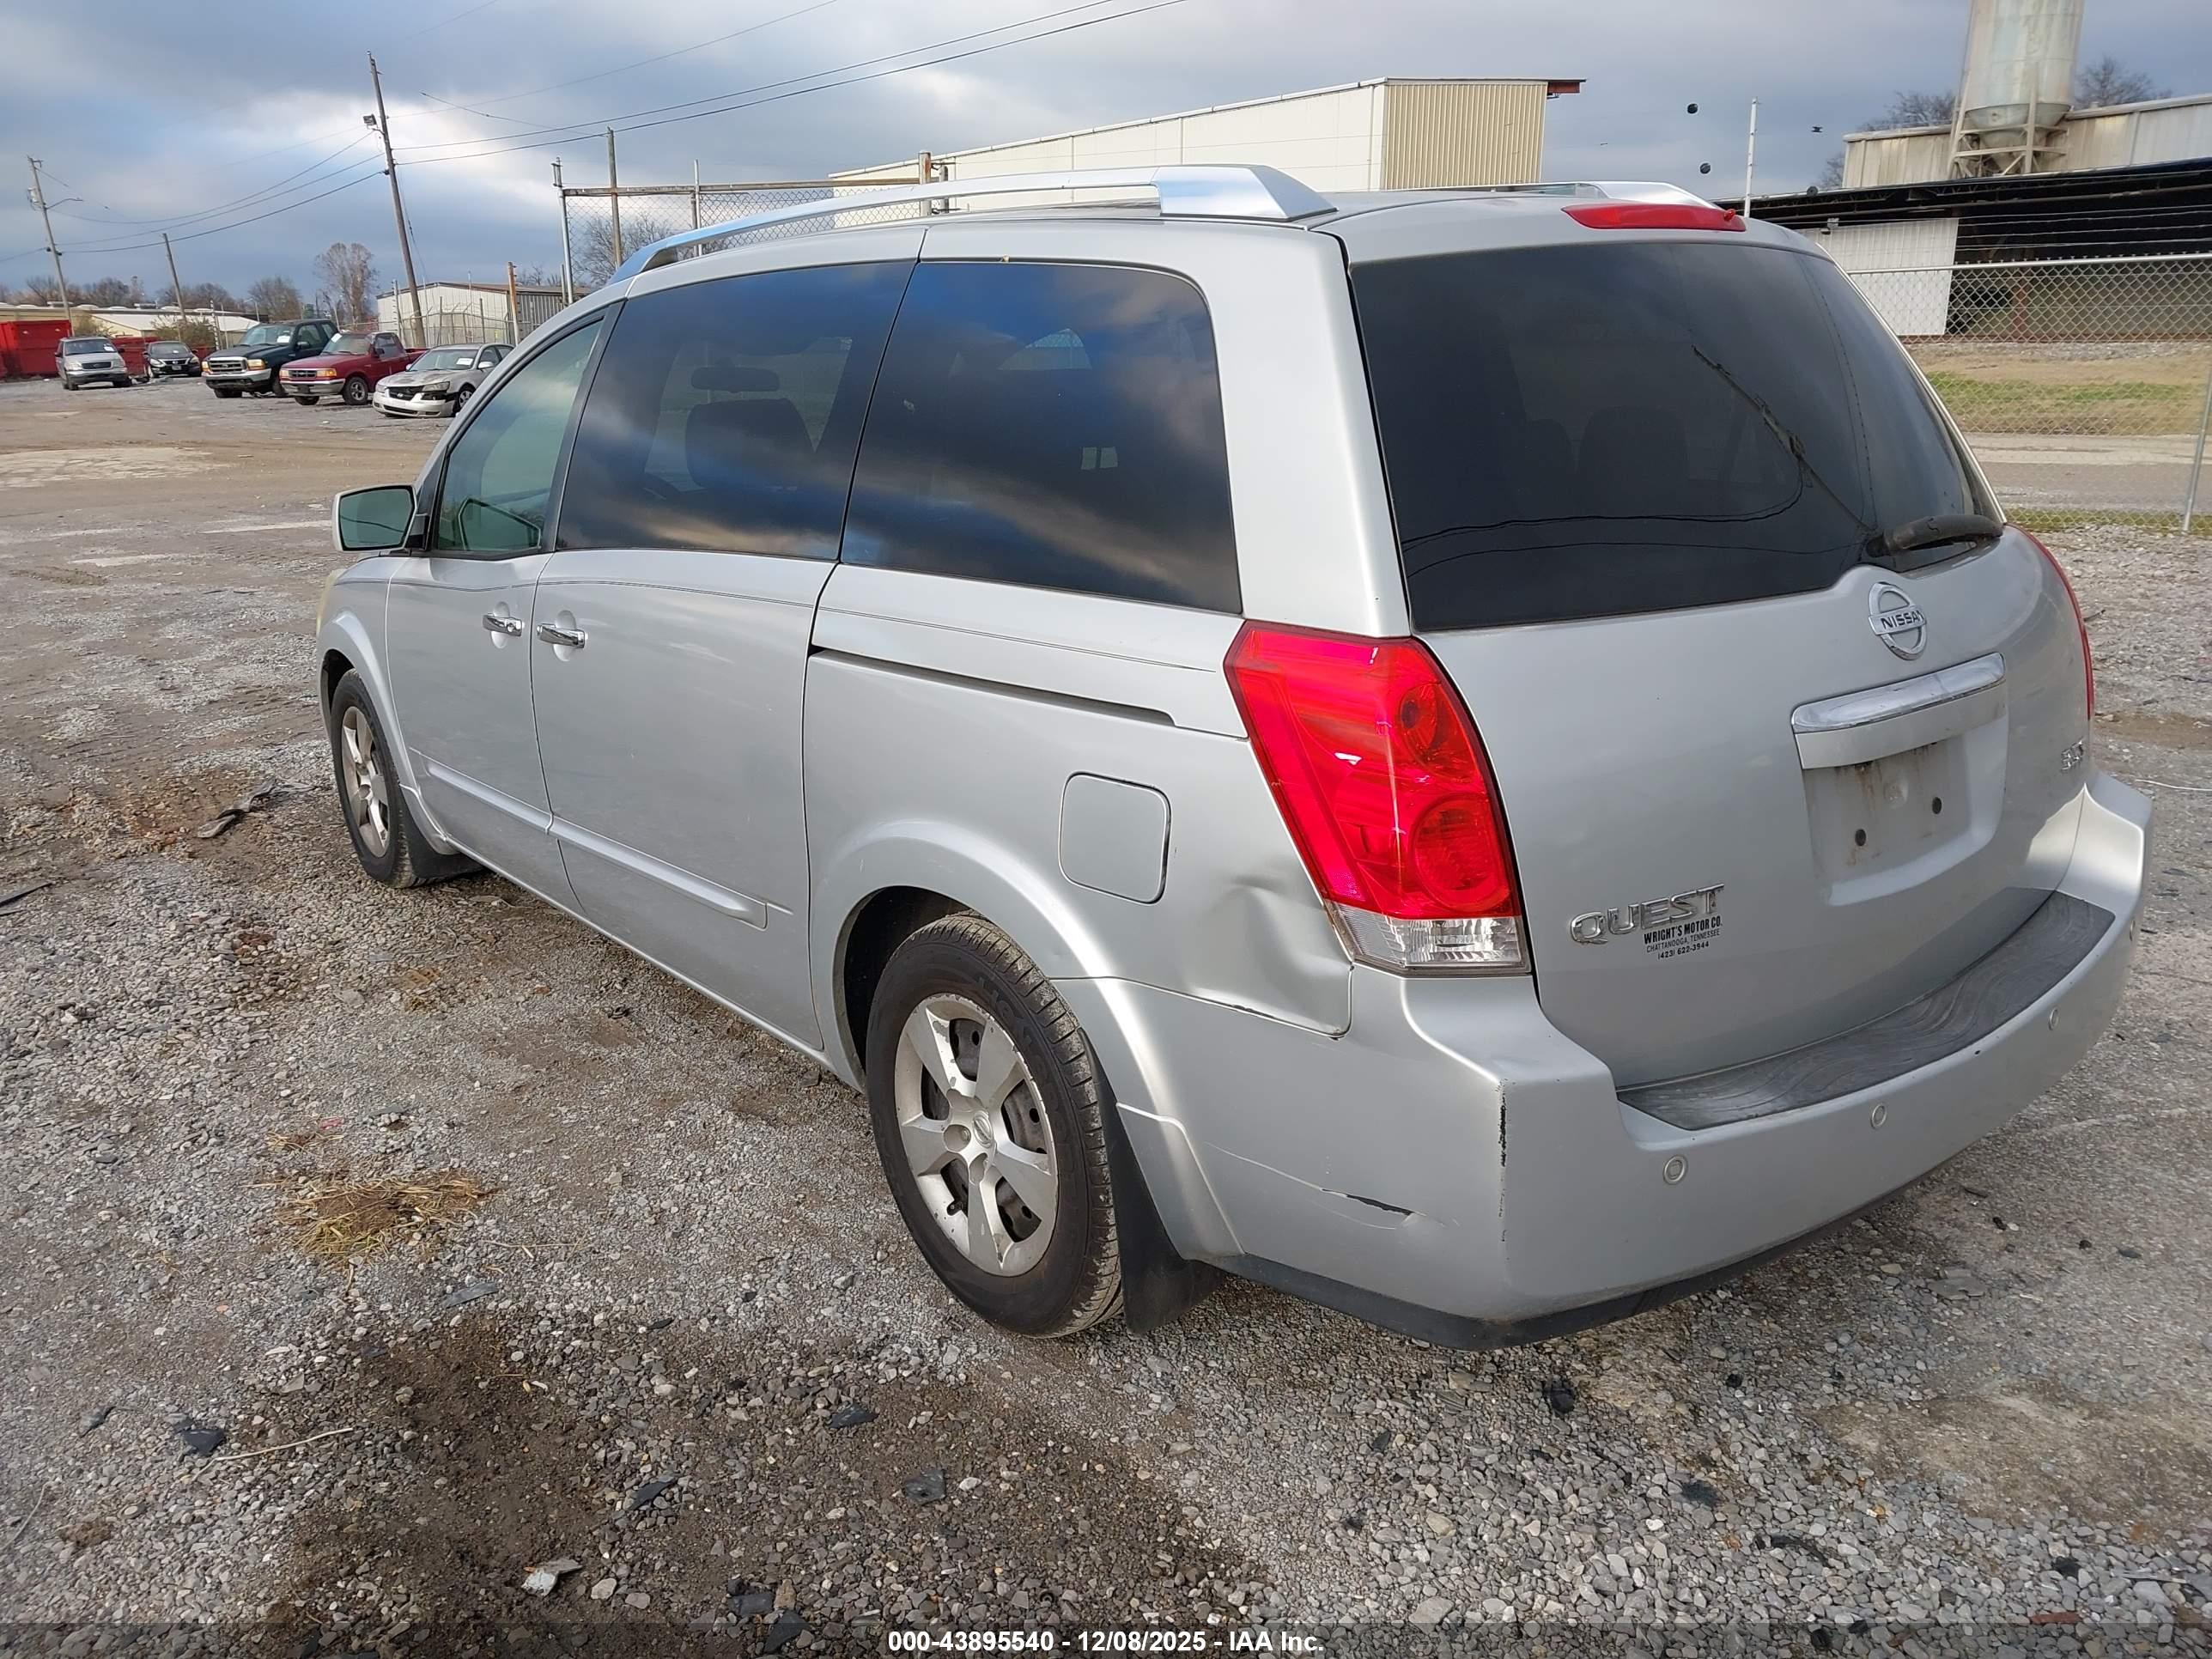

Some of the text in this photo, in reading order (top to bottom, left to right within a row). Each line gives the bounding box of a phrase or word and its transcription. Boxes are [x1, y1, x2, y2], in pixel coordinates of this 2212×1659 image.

[1570, 883, 1725, 945] QUEST
[1644, 915, 1723, 945] WRIGHT'S MOTOR CO.
[1690, 928, 1721, 942] TENNESSEE
[1677, 940, 1710, 956] 622-3944
